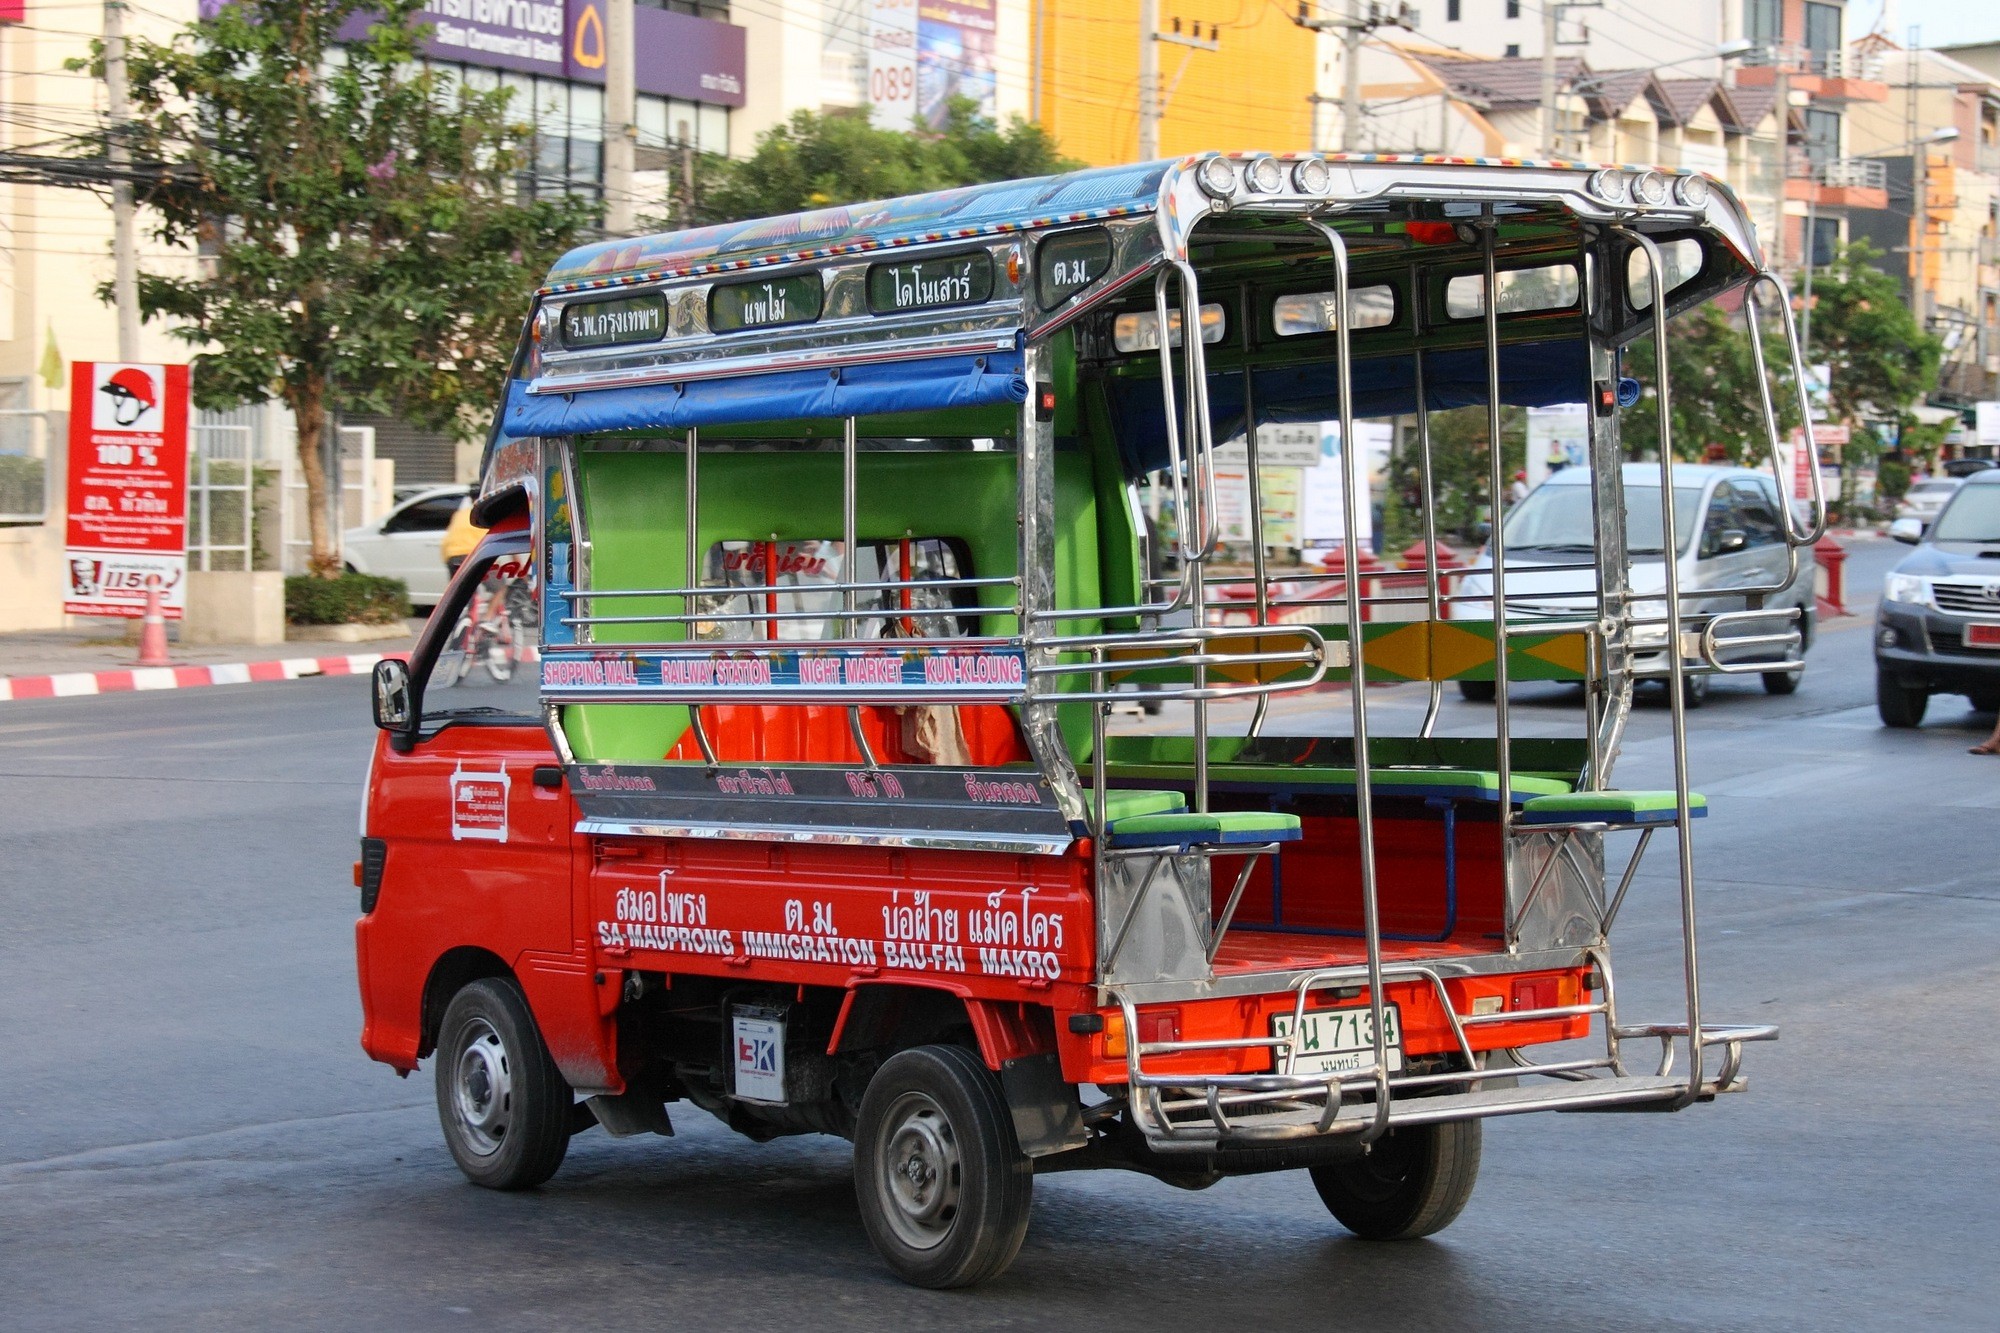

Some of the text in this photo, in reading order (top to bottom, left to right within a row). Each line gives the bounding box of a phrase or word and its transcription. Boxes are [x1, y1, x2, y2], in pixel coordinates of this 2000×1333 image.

[872, 66, 913, 102] 089
[889, 262, 971, 307] ไดโนเสาร์
[1053, 259, 1091, 286] ต.ม.
[744, 285, 786, 324] แพไม้
[571, 308, 659, 341] ร.พ.กรุงเทพฯ
[96, 445, 158, 466] 100 %
[543, 655, 1023, 686] SHOPPING MALL RAILWAY STATION NIGHT MARKET KUN-KLOUNG
[716, 766, 795, 795] สถานีรถไฟ
[845, 772, 905, 798] ตลาด
[616, 869, 706, 925] สมอโพรง
[784, 899, 838, 935] ต.ม.
[882, 887, 1063, 949] บ่อฝ้าย แม็คโคร
[598, 921, 1061, 979] SA-MAUPRONG IMMIGRATION BAU-FAI MAKRO
